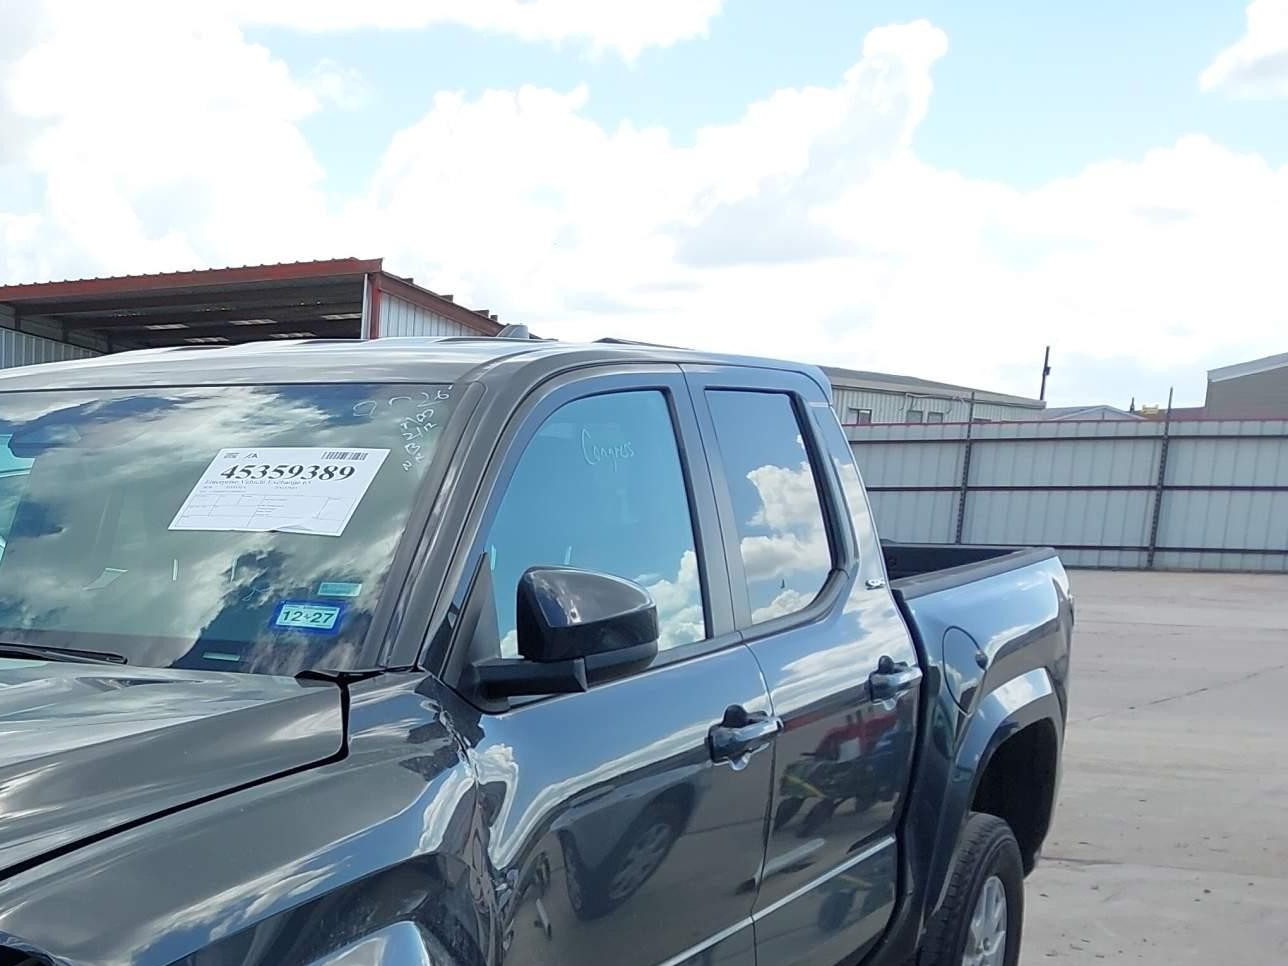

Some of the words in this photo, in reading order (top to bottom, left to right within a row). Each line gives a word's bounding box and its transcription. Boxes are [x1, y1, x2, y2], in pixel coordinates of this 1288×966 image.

[220, 464, 356, 481] 45359389
[282, 610, 303, 622] 12
[310, 612, 334, 624] 27
